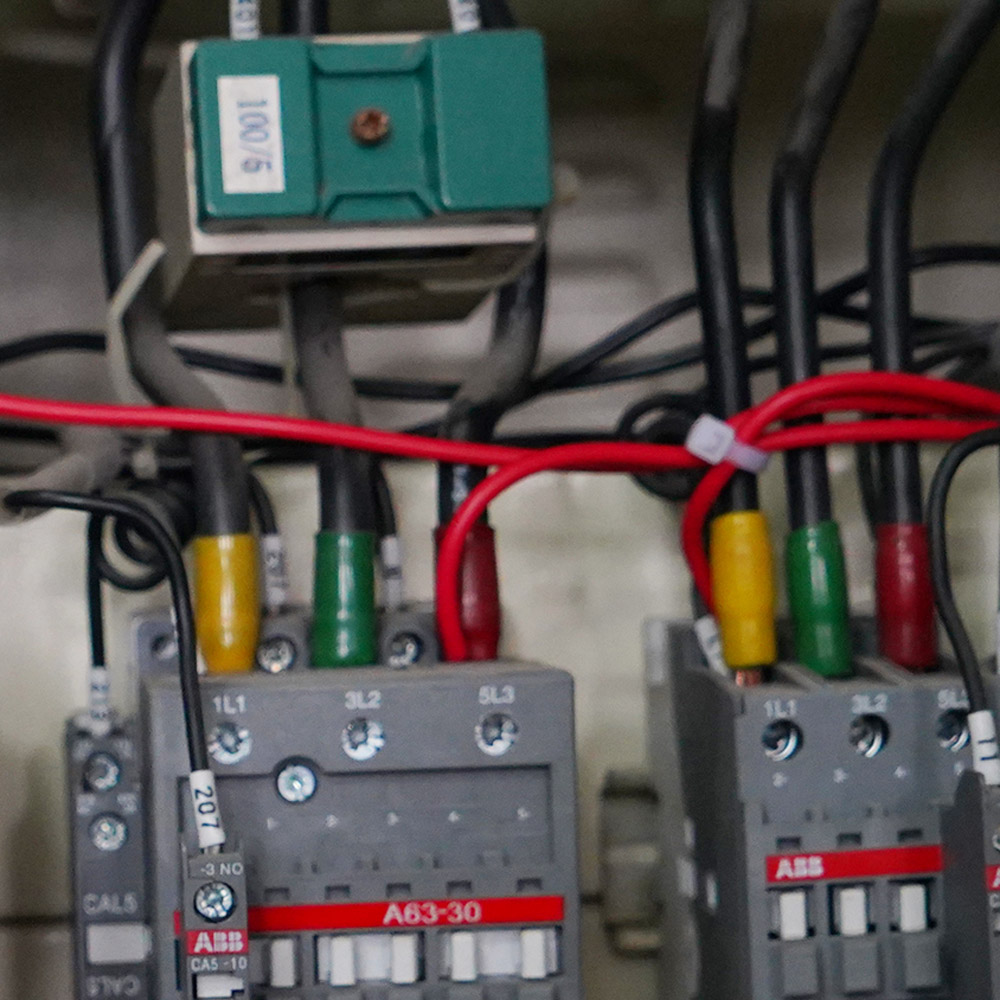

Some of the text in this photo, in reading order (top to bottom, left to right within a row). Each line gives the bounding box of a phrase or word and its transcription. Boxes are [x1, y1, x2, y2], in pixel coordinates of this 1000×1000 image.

[195, 785, 220, 830] 207
[219, 862, 244, 876] NO
[775, 857, 824, 880] ABB
[382, 901, 482, 926] A63-30
[193, 931, 244, 953] ABB
